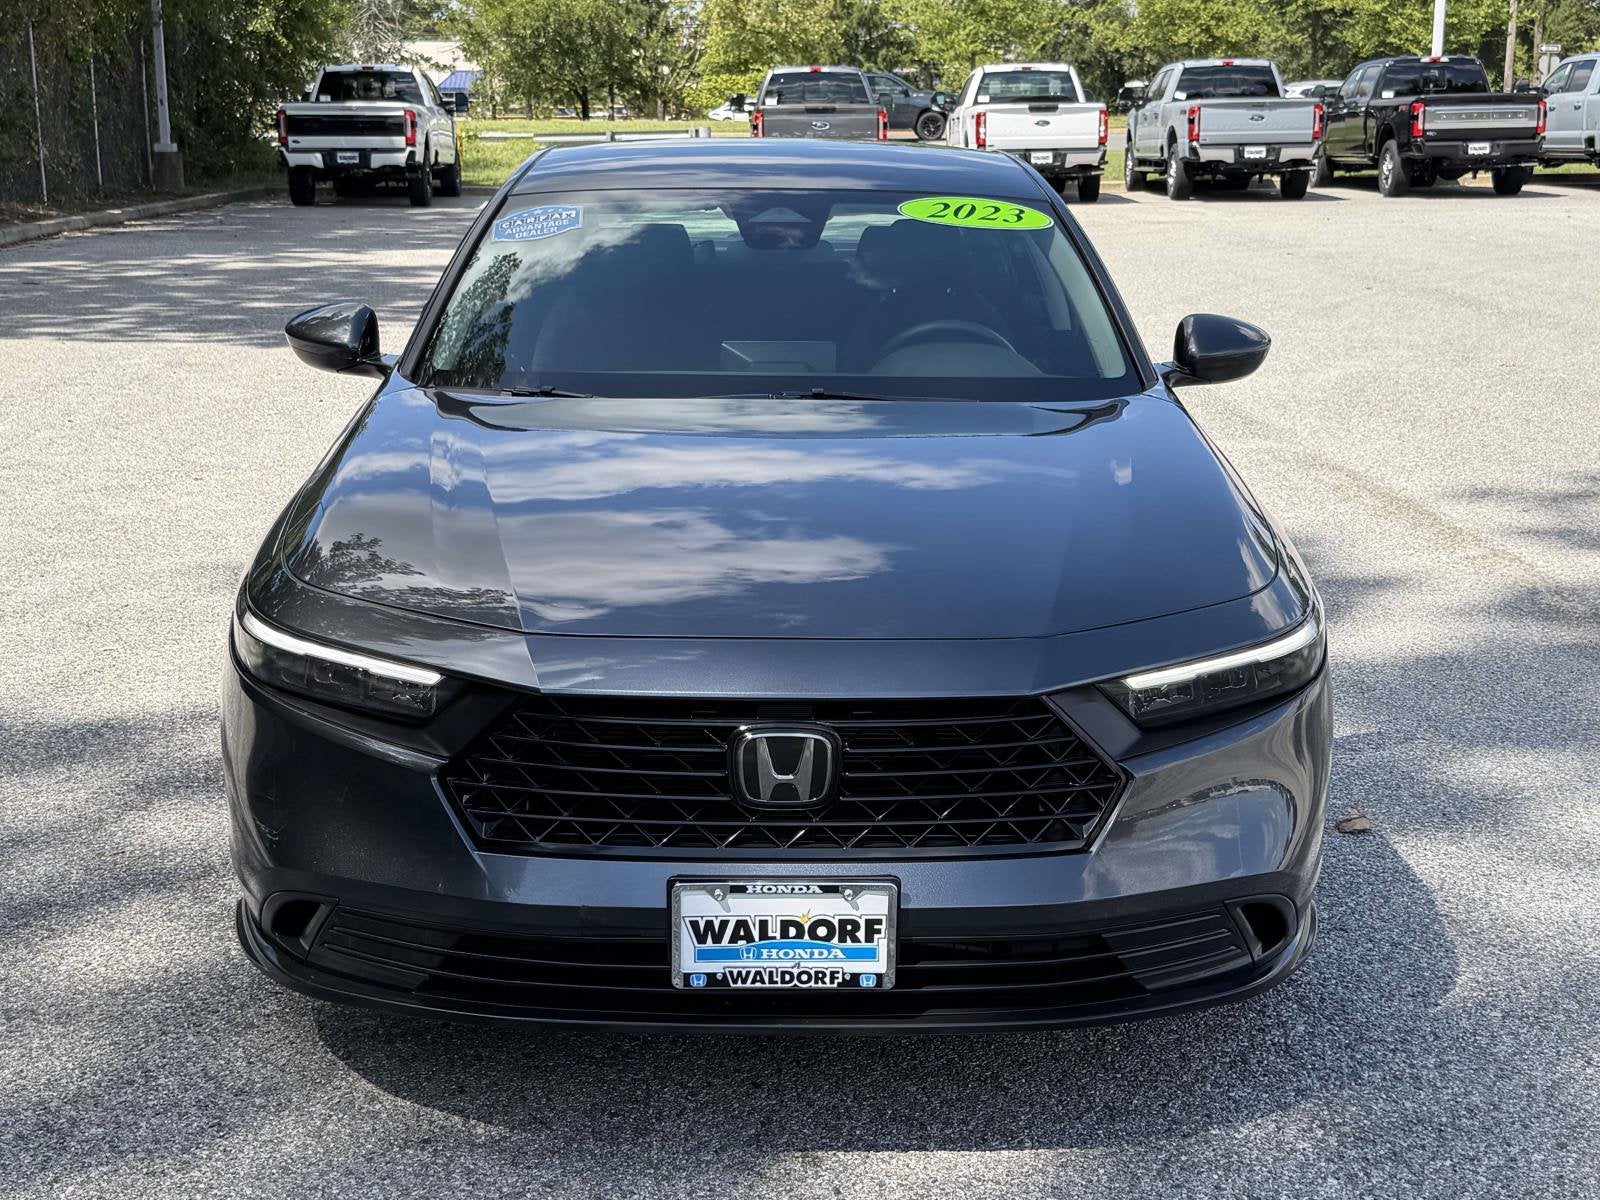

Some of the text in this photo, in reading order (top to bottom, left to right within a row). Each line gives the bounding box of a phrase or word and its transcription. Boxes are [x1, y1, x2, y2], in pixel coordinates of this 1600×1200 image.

[927, 202, 1026, 224] 2023
[505, 219, 569, 235] ADVANTAGE
[515, 227, 558, 239] DEALER
[746, 885, 823, 894] HONDA
[689, 918, 883, 945] WALDORF
[760, 947, 847, 959] HONDA
[727, 969, 841, 986] WALDORF
